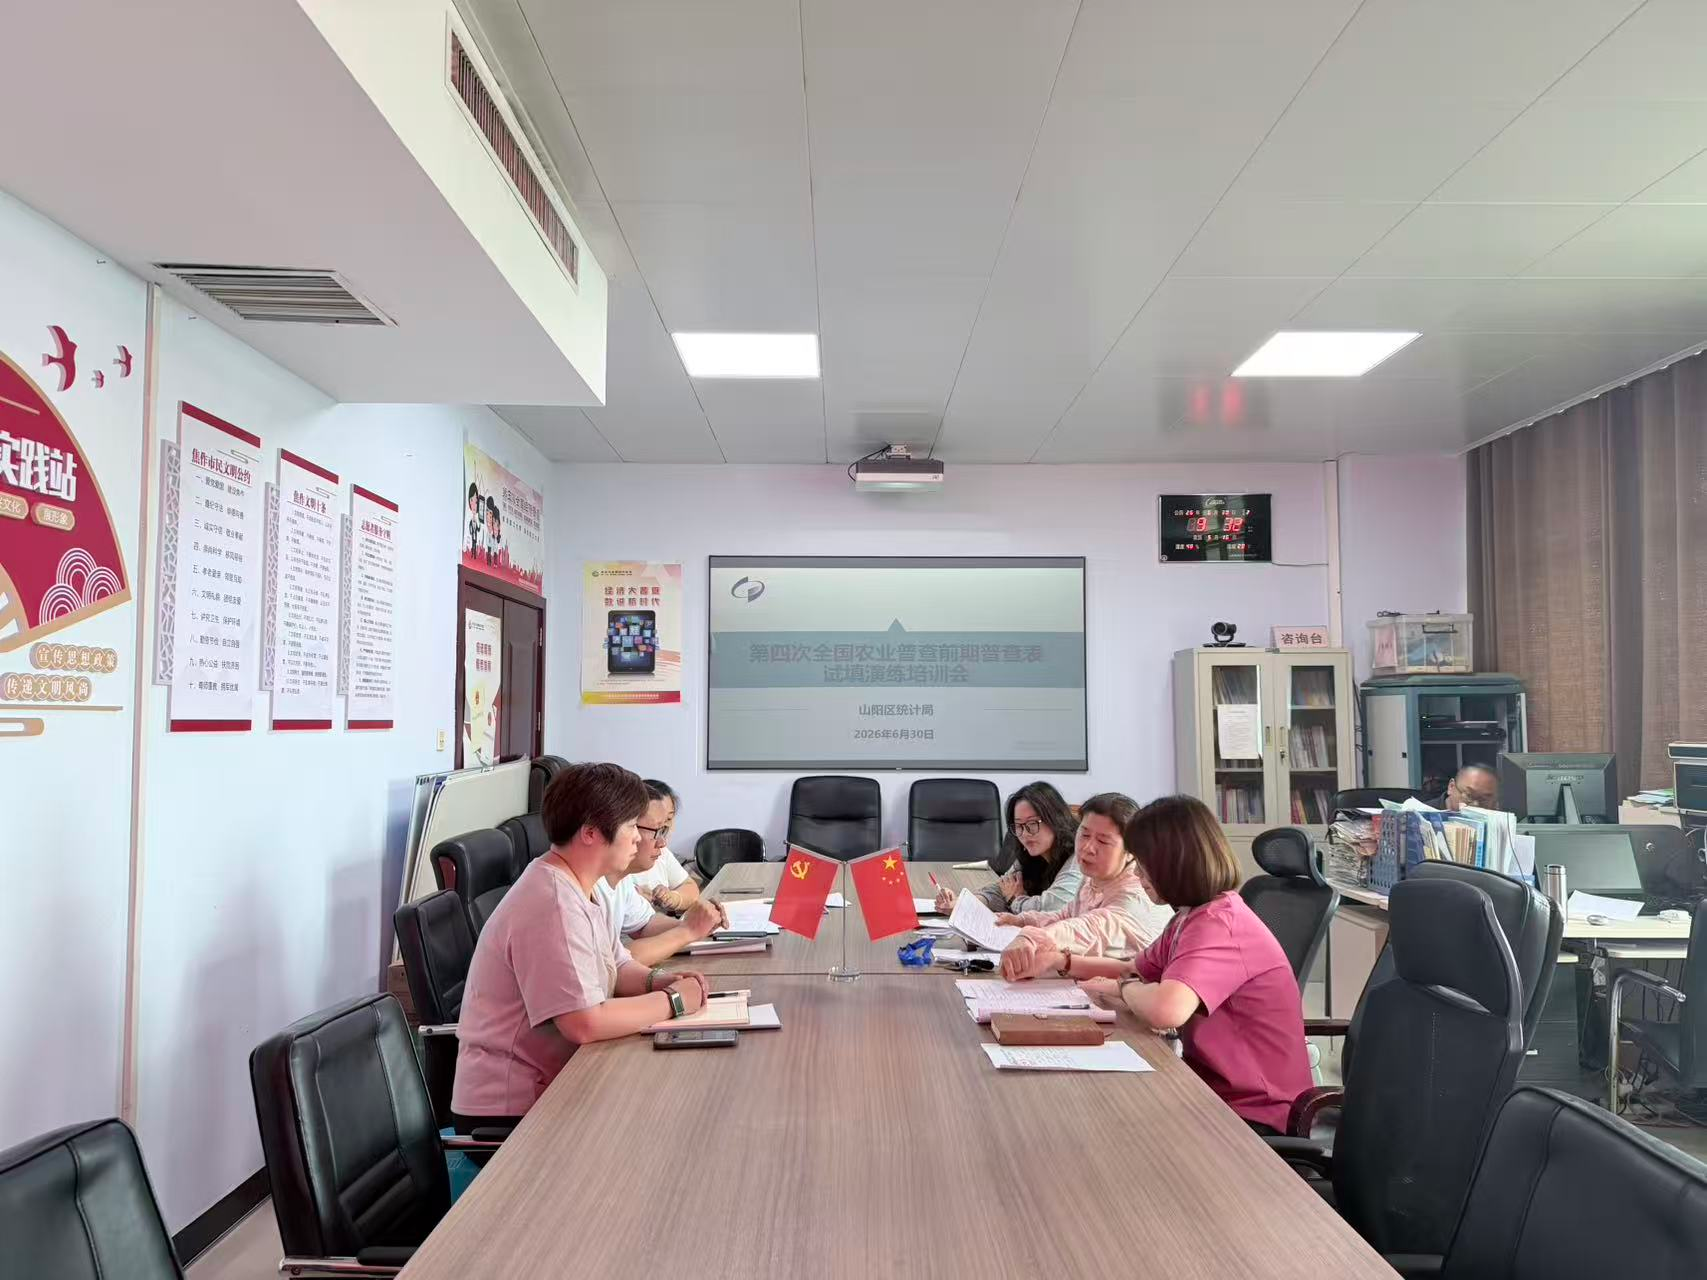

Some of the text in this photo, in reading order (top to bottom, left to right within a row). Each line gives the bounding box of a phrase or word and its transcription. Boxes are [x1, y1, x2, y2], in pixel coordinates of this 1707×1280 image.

[0, 430, 77, 501] 实践站
[191, 447, 251, 485] 焦作市民文明公约
[0, 497, 21, 514] 文化
[293, 490, 327, 514] 焦作文明十条
[604, 586, 661, 596] 经济大普查
[1280, 632, 1323, 646] 咨询台
[38, 647, 115, 668] 宣传思想政策
[749, 644, 1043, 663] 第四次全国农业普查前期普查表
[823, 664, 969, 684] 试填演练培训会
[6, 678, 88, 696] 传递文明风尚
[858, 704, 934, 717] 山阳区统计局
[853, 728, 935, 741] 2026年6月30日
